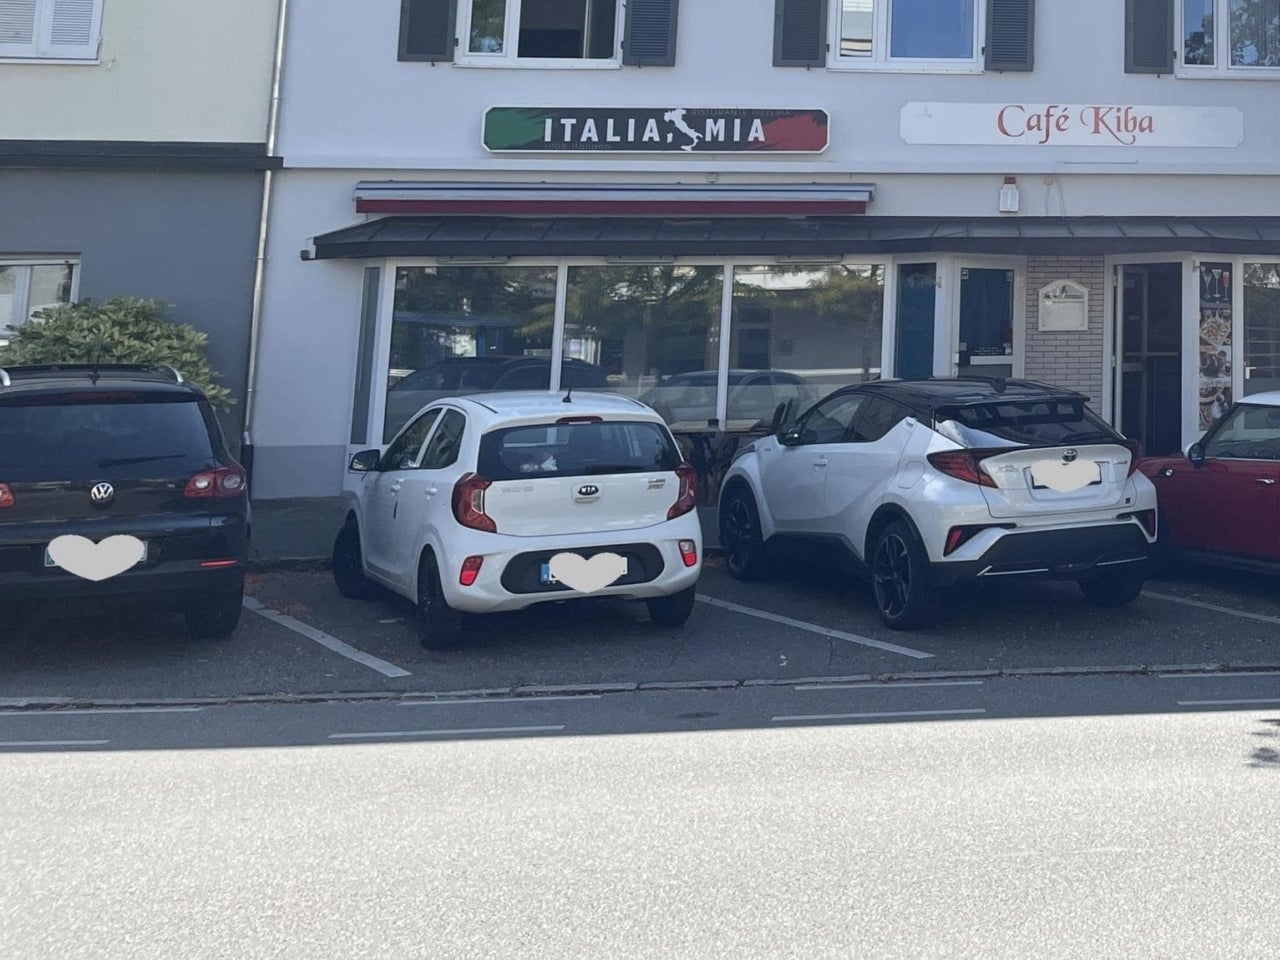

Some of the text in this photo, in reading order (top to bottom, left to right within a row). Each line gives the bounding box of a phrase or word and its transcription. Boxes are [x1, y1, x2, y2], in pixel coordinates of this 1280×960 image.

[544, 118, 766, 142] ITALIA MIA
[997, 104, 1154, 145] Café Kiba
